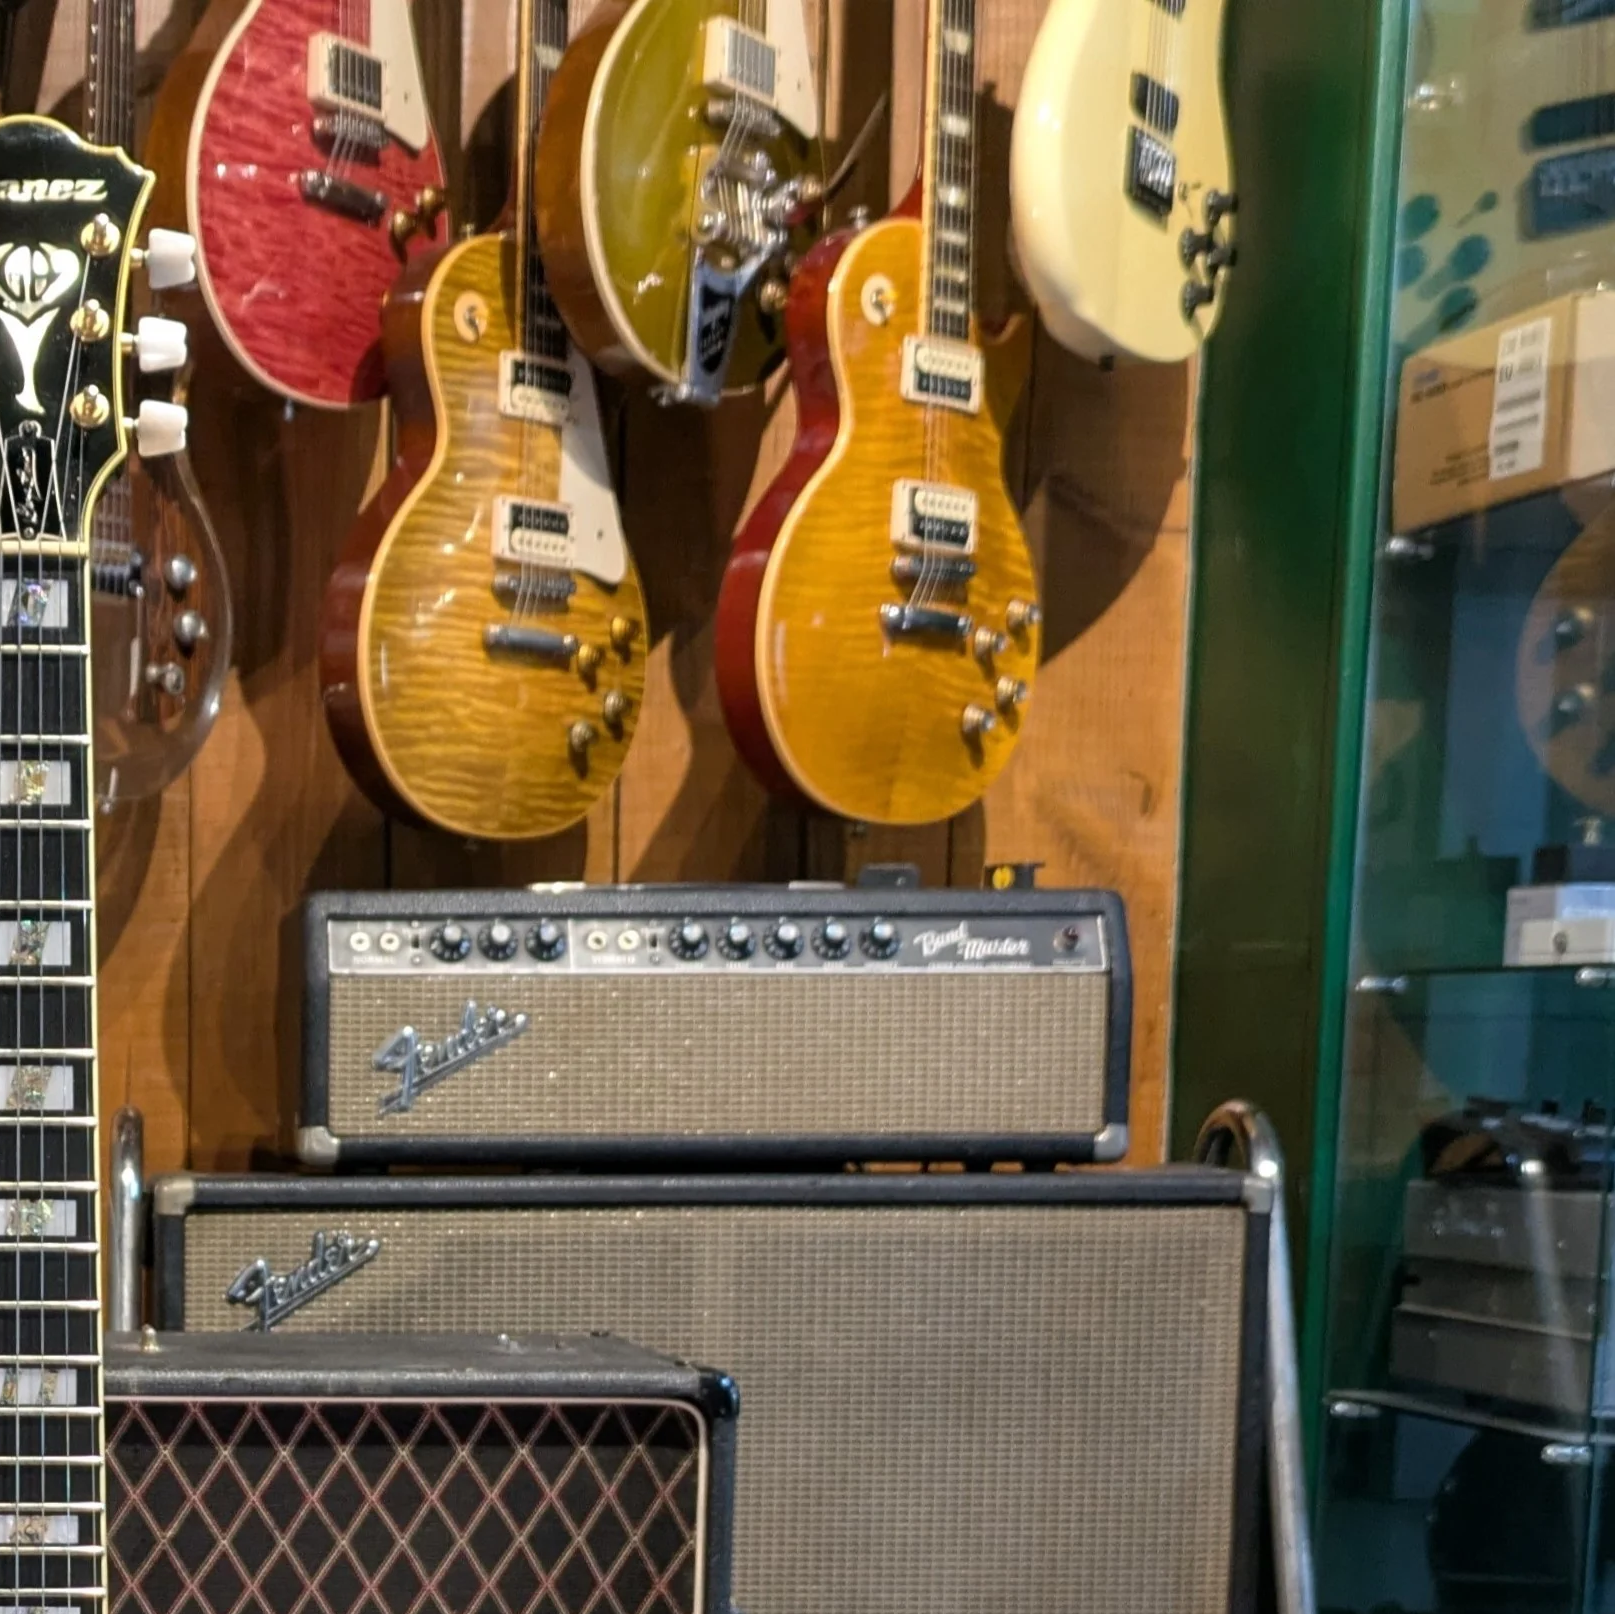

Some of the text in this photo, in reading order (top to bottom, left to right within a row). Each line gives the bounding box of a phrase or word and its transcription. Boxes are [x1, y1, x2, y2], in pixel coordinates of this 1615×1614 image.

[913, 920, 1031, 960] Band Master
[372, 997, 529, 1118] Fender
[225, 1228, 380, 1332] Fender
